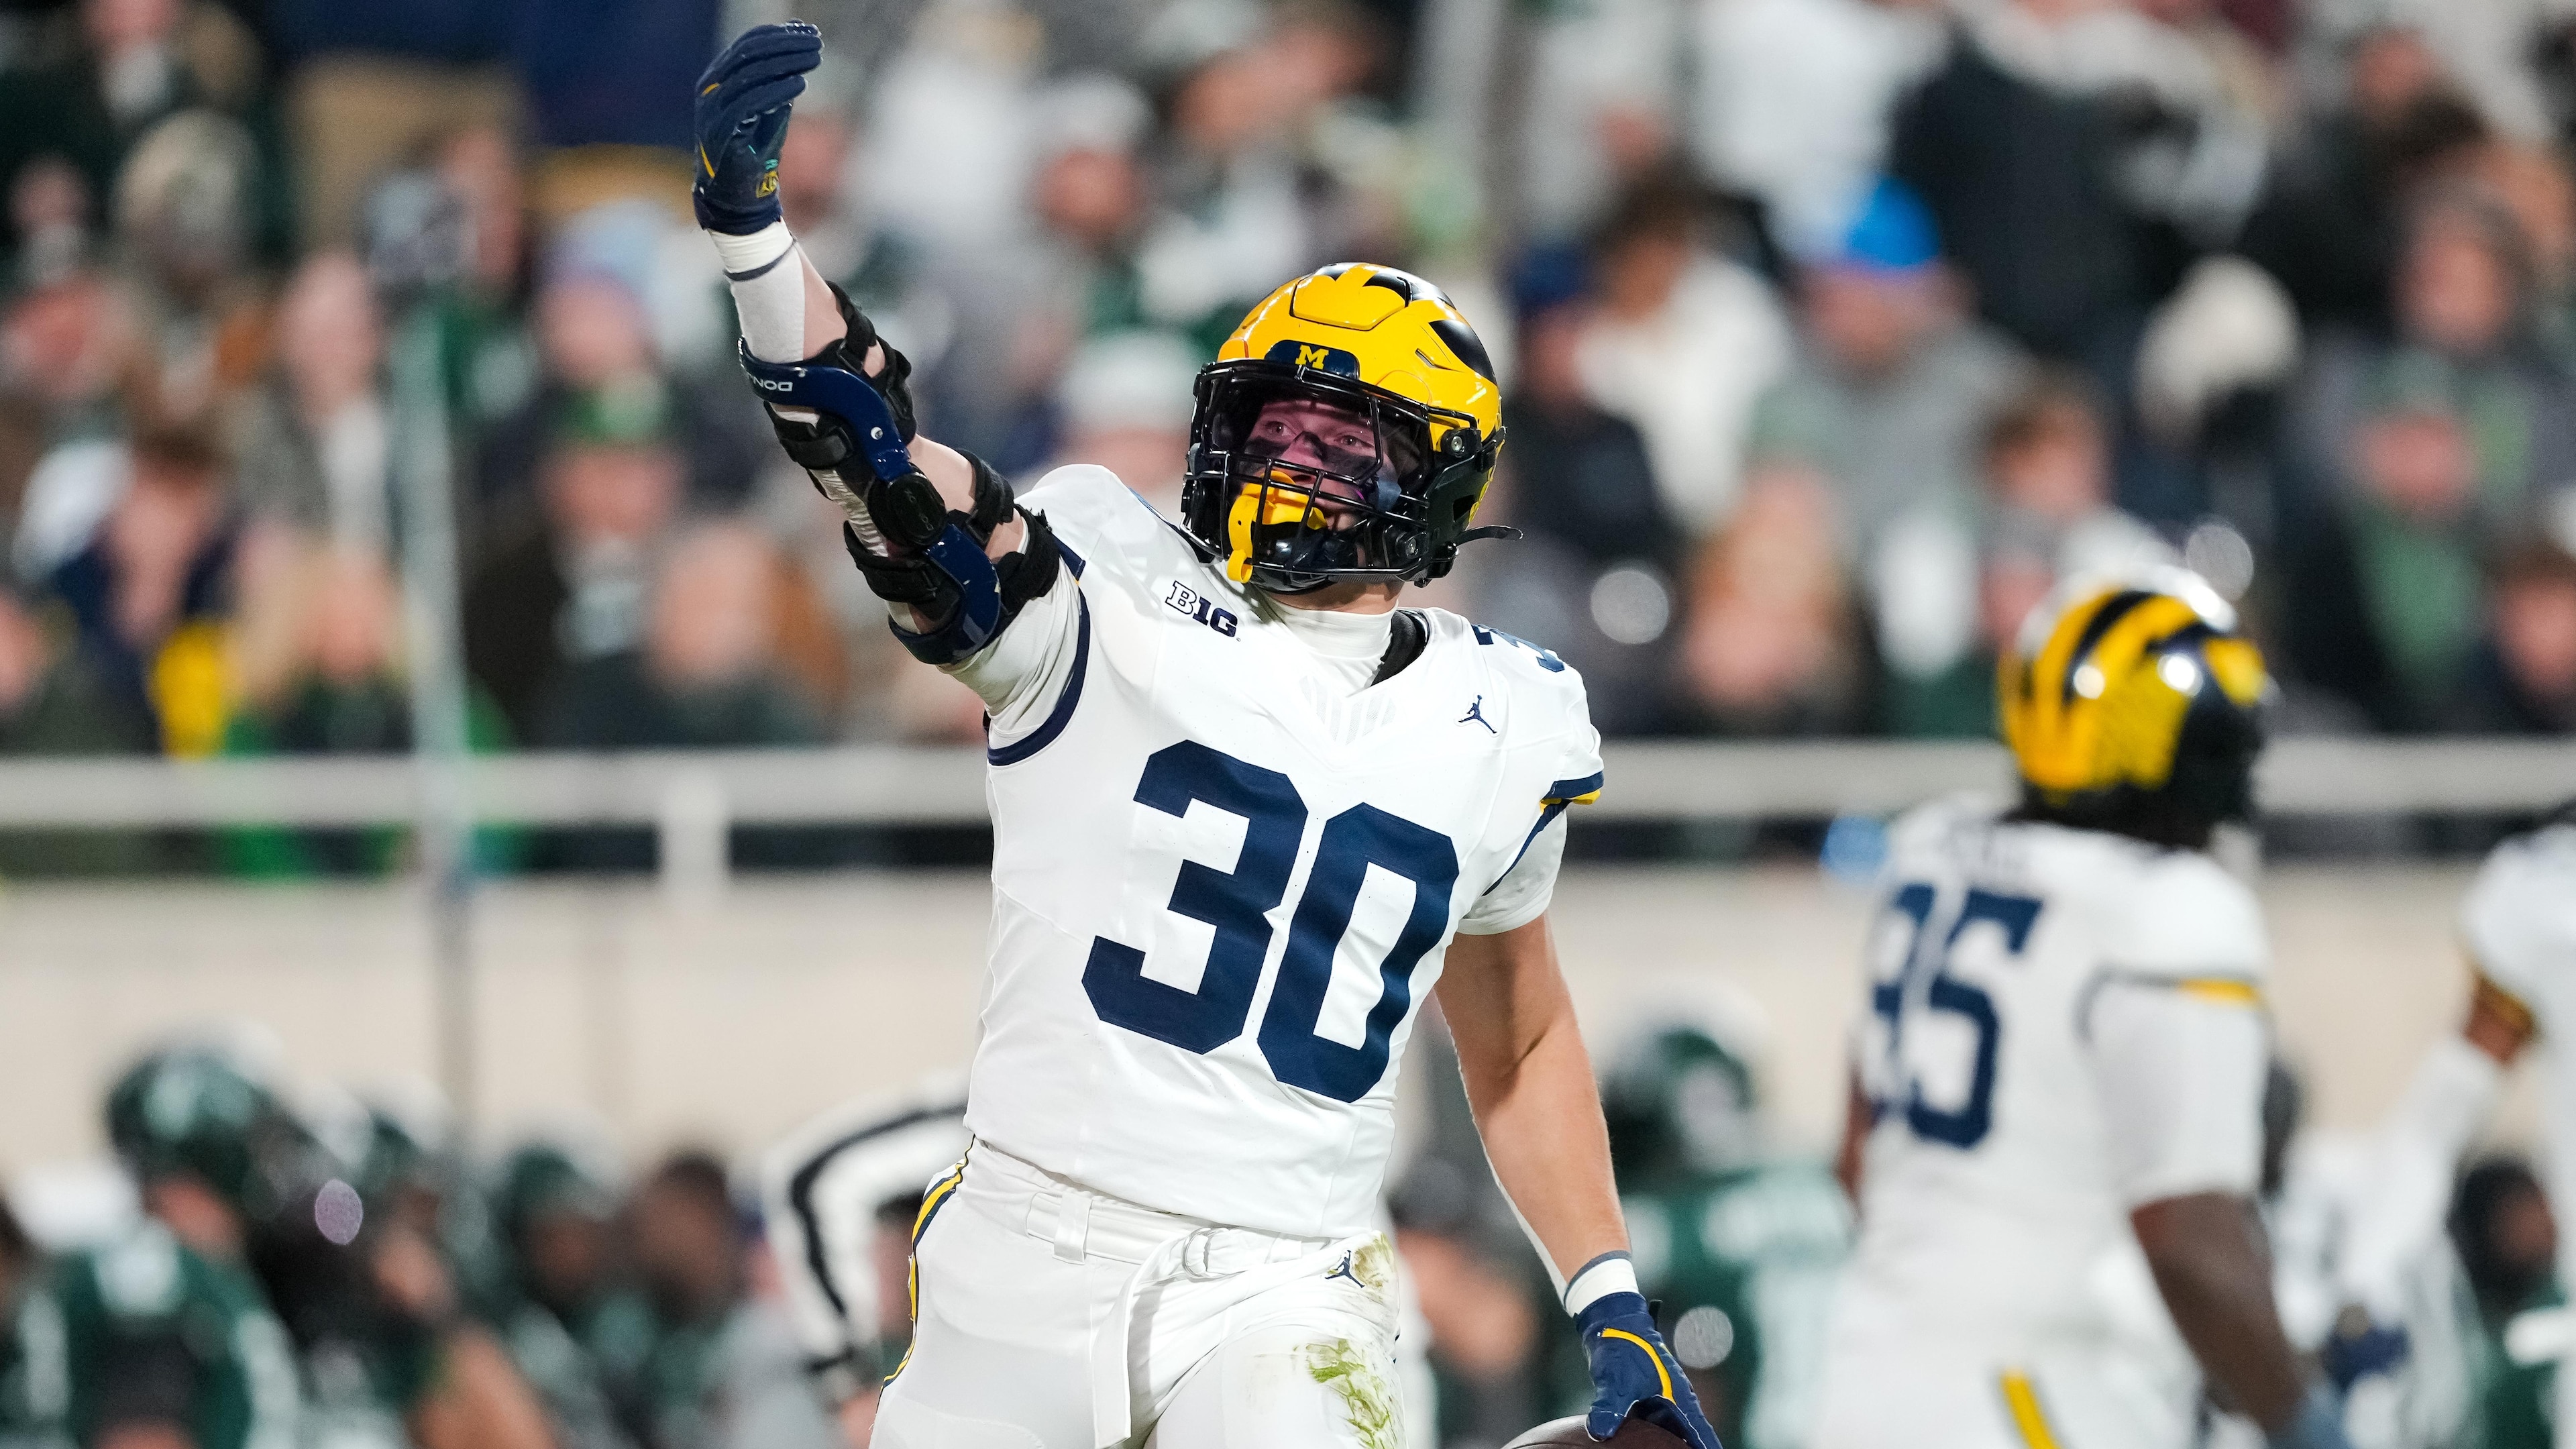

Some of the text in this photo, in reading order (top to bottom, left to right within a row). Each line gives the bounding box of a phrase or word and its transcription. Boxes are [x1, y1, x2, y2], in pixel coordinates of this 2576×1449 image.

[1295, 344, 1329, 370] M
[748, 374, 794, 392] DON
[1081, 739, 1460, 1104] 30
